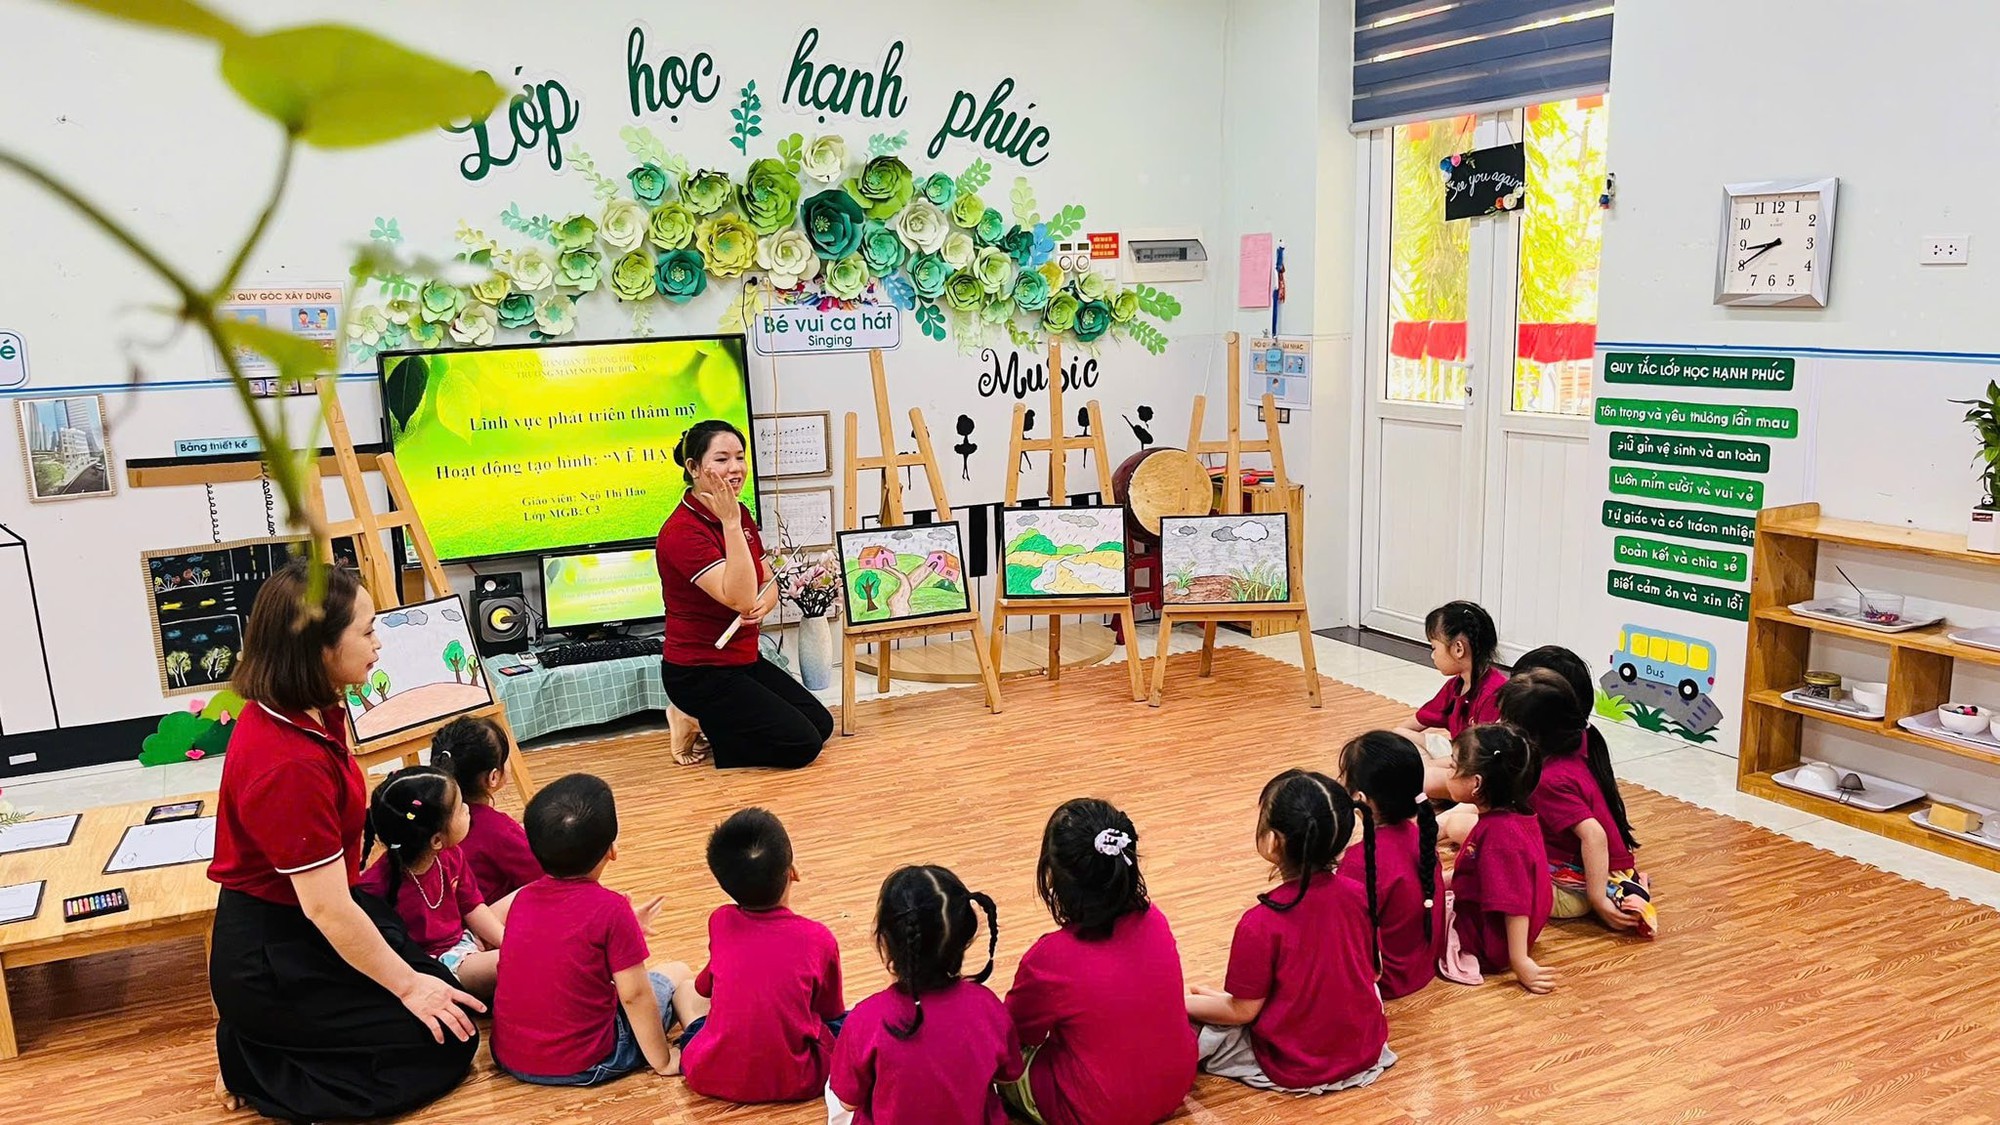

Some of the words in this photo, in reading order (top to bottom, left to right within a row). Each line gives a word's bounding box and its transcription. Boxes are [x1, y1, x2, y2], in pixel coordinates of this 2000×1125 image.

[442, 65, 579, 181] Lớp
[627, 26, 720, 123] học
[782, 27, 908, 124] hạnh
[927, 77, 1050, 167] phúc
[1469, 173, 1491, 197] you
[1755, 202, 1764, 214] 11
[1772, 201, 1785, 213] 12
[1795, 200, 1800, 213] 1
[1740, 218, 1751, 230] 10
[1808, 214, 1816, 227] 2
[1740, 239, 1747, 251] 9
[1806, 237, 1814, 250] 3
[1804, 260, 1812, 271] 4
[1750, 274, 1757, 286] 7
[1768, 274, 1776, 286] 6
[1787, 274, 1794, 286] 5
[238, 293, 258, 301] QUY
[764, 314, 789, 334] Bé
[796, 315, 824, 332] vui
[830, 318, 856, 331] ca
[862, 311, 892, 330] hát
[808, 335, 853, 348] Singing
[1610, 362, 1634, 374] QUY
[1638, 356, 1658, 375] TẮC
[1660, 358, 1681, 376] LỚP
[1684, 366, 1710, 381] HỌC
[1713, 367, 1748, 382] HẠNH
[1752, 362, 1786, 381] PHÚC
[470, 416, 508, 431] Lĩnh
[515, 414, 542, 431] vực
[548, 410, 584, 429] phát
[675, 402, 697, 419] mỹ
[1600, 404, 1616, 417] Tôn
[1620, 408, 1646, 422] trọng
[1647, 408, 1662, 420] và
[1666, 410, 1686, 423] yêu
[1732, 408, 1751, 426] lẫn
[180, 442, 208, 453] Bảng
[1637, 436, 1654, 454] gìn
[1656, 442, 1670, 458] vệ
[1674, 442, 1696, 456] sinh
[1700, 444, 1714, 458] và
[1717, 450, 1732, 460] an
[1735, 449, 1761, 463] toàn
[436, 466, 476, 480] Hoạt
[482, 460, 522, 478] động
[528, 459, 552, 474] tạo
[557, 454, 598, 469] hình:
[1614, 473, 1638, 486] Luôn
[1641, 473, 1665, 490] mỉm
[1668, 476, 1694, 494] cười
[1696, 481, 1711, 496] và
[1714, 486, 1734, 498] vui
[1737, 486, 1754, 502] vẻ
[580, 491, 600, 502] Ngô
[550, 507, 583, 519] MGB:
[1608, 508, 1621, 524] Tự
[1624, 510, 1648, 524] giác
[1650, 512, 1665, 528] và
[1668, 516, 1684, 529] có
[1620, 542, 1648, 558] Đoàn
[1652, 546, 1670, 561] kết
[1673, 550, 1688, 564] và
[1692, 556, 1718, 569] chia
[1723, 556, 1738, 572] sẻ
[1614, 576, 1634, 590] Biết
[1636, 579, 1660, 596] cảm
[1683, 587, 1698, 602] và
[1703, 593, 1722, 606] xin
[1727, 592, 1744, 612] lỗi
[1646, 664, 1665, 679] Bus
